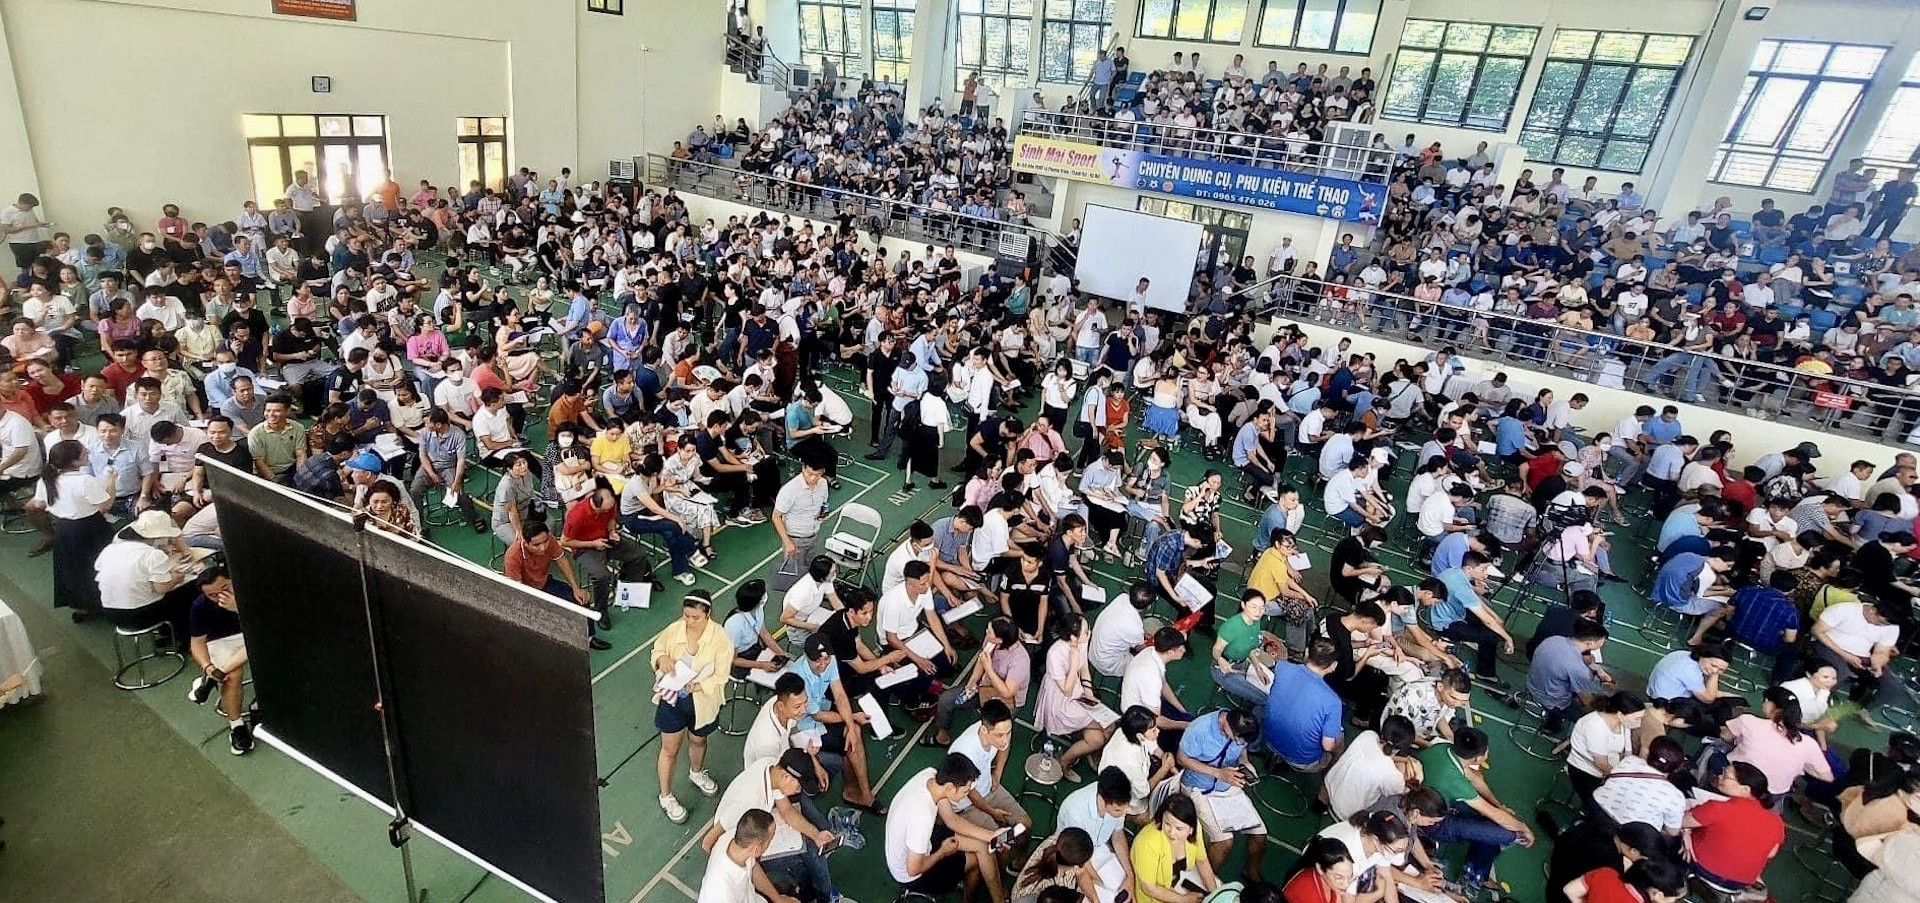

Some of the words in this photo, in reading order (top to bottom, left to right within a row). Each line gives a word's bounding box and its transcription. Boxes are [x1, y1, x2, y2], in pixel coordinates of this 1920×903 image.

[1020, 143, 1043, 160] Sinh
[1044, 147, 1066, 163] Mai
[1067, 150, 1098, 168] Sport
[1139, 160, 1180, 181] CHUYÊN
[1181, 166, 1213, 185] DỤNG
[1214, 171, 1233, 190] CỤ,
[1235, 174, 1261, 194] PHỤ
[1261, 176, 1291, 198] KIỆN
[1292, 178, 1319, 200] THỂ
[1317, 185, 1350, 205] THAO
[1213, 191, 1238, 204] 0965
[1258, 196, 1276, 208] 026
